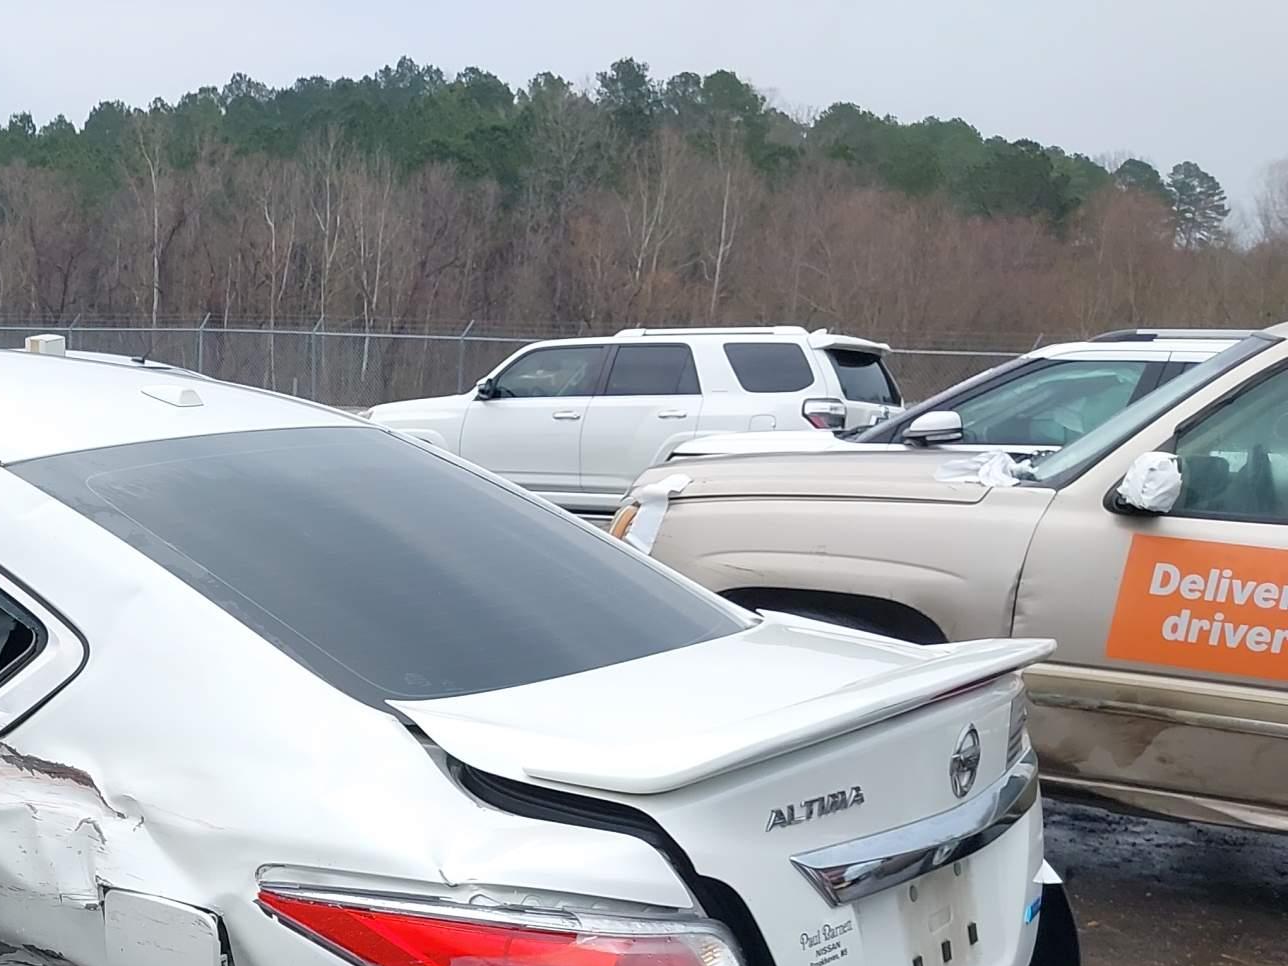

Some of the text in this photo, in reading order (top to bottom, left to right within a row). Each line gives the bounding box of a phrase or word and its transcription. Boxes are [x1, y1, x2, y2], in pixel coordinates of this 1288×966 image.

[1162, 609, 1288, 654] driver
[765, 786, 865, 833] ALTIMA
[800, 930, 821, 951] Paul
[815, 941, 841, 957] NISSAN
